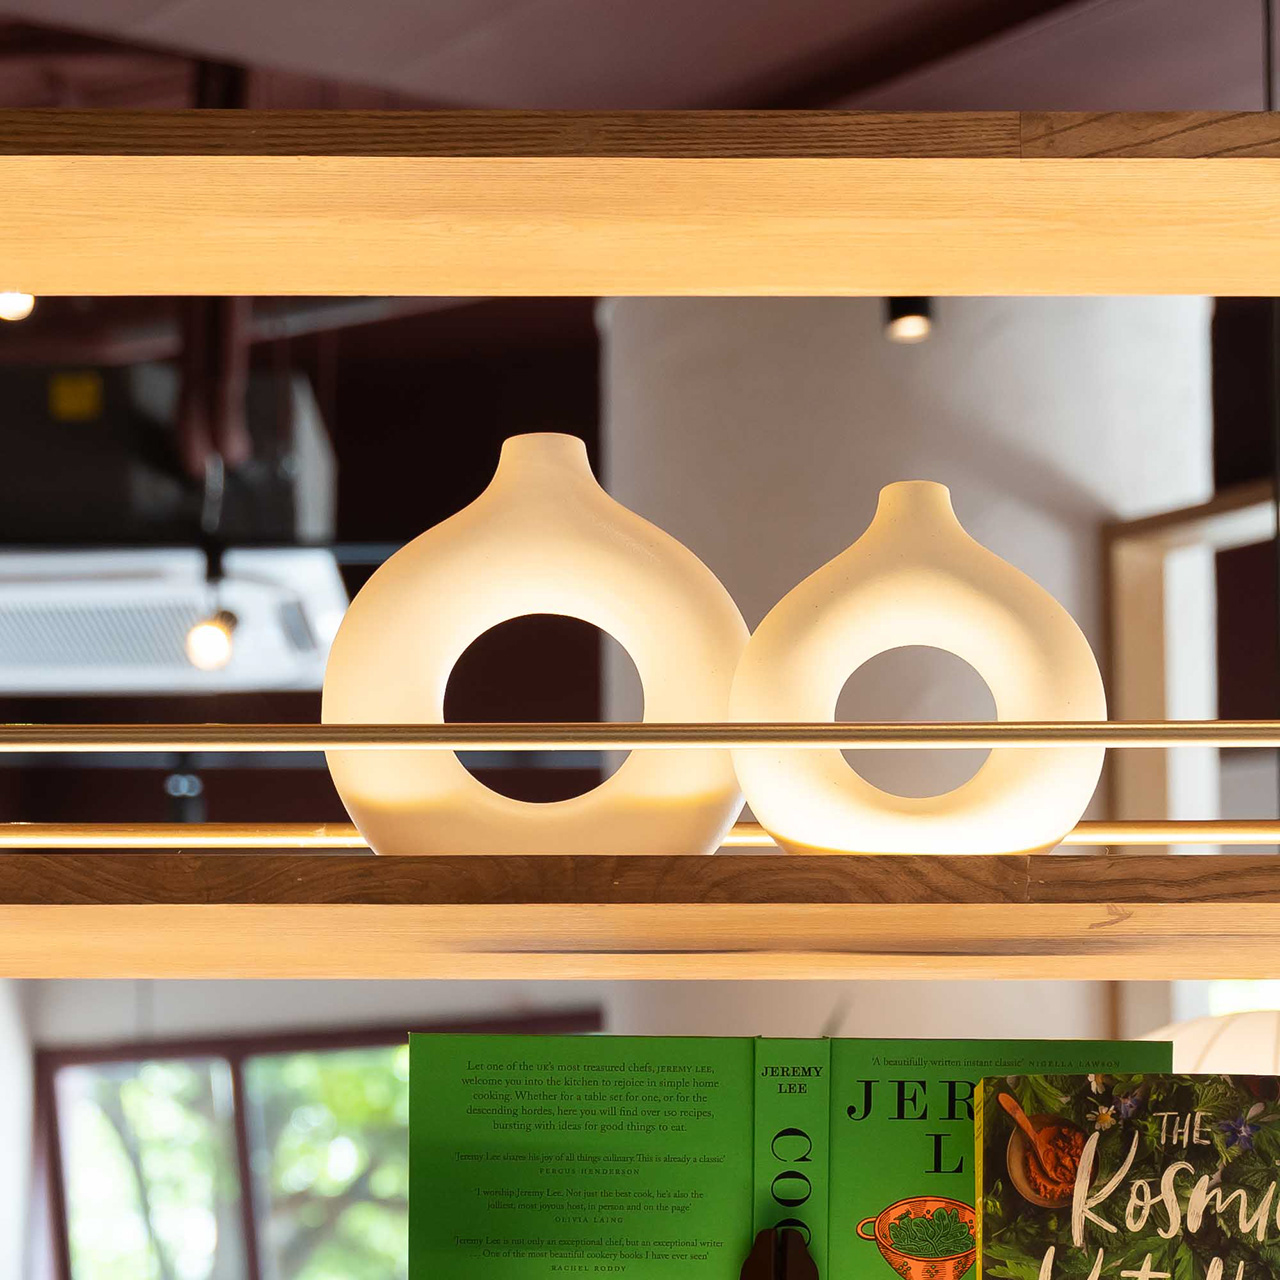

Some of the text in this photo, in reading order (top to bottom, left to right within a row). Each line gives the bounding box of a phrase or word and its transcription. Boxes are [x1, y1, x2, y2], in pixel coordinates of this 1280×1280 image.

[467, 1061, 485, 1071] Let
[518, 1061, 534, 1071] the
[557, 1063, 581, 1072] most
[583, 1062, 626, 1072] treasured
[627, 1063, 655, 1075] chefs,
[761, 1066, 823, 1078] JEREMY
[461, 1076, 503, 1086] welcome
[504, 1079, 523, 1089] you
[524, 1077, 544, 1086] into
[545, 1076, 562, 1086] the
[563, 1077, 600, 1086] kitchen
[613, 1078, 645, 1090] rejoice
[658, 1077, 691, 1090] simple
[692, 1077, 719, 1087] home
[777, 1083, 807, 1094] LEE
[472, 1090, 513, 1103] cooking.
[514, 1090, 558, 1101] Whether
[559, 1091, 574, 1101] for
[584, 1091, 608, 1101] table
[609, 1093, 624, 1102] set
[625, 1092, 640, 1102] for
[641, 1095, 662, 1104] one,
[676, 1092, 691, 1103] for
[692, 1093, 708, 1103] the
[846, 1079, 974, 1121] JER
[466, 1105, 520, 1118] descending
[521, 1105, 555, 1117] hordes,
[556, 1106, 578, 1116] here
[579, 1109, 597, 1119] you
[598, 1106, 618, 1116] will
[619, 1106, 639, 1117] find
[679, 1109, 714, 1121] recipes,
[492, 1120, 533, 1134] bursting
[534, 1120, 556, 1131] with
[557, 1120, 583, 1131] ideas
[584, 1120, 599, 1131] for
[600, 1120, 624, 1134] good
[625, 1121, 657, 1134] things
[670, 1123, 687, 1132] eat.
[1153, 1112, 1212, 1148] THE
